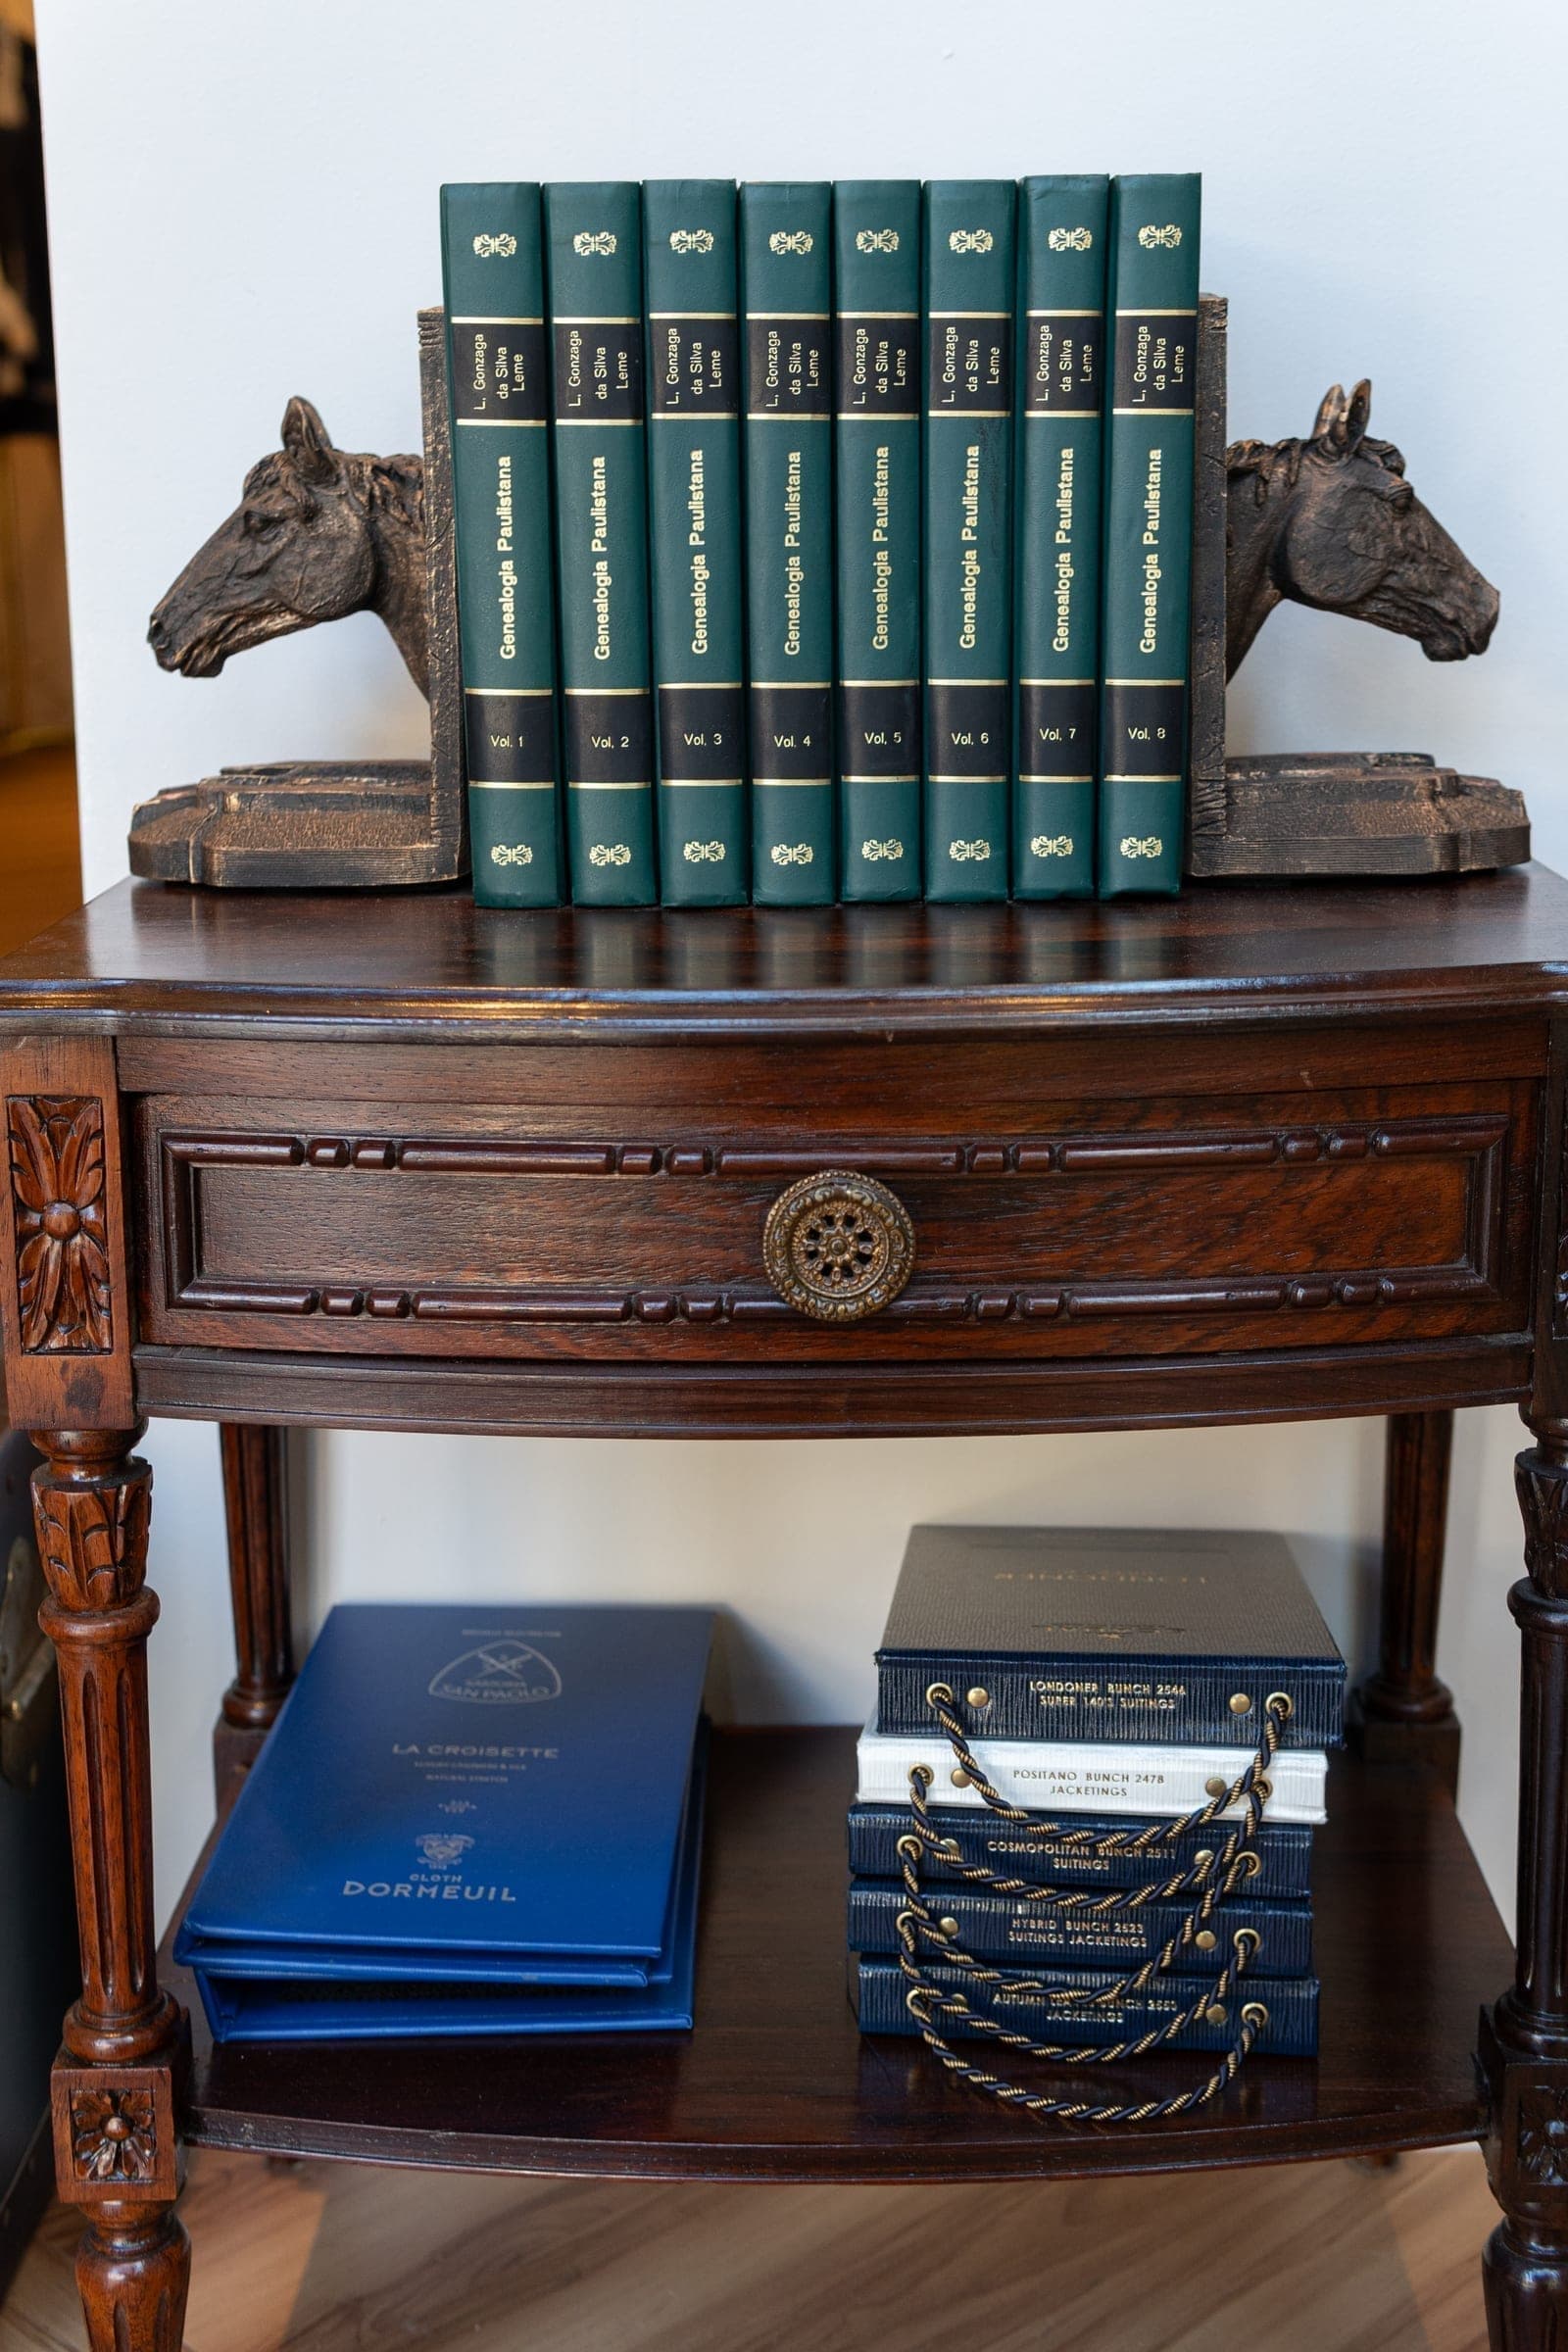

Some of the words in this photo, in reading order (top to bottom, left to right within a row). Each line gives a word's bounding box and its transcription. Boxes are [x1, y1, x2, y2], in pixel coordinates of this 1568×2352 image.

[474, 333, 487, 390] Gonzaga
[496, 347, 508, 378] Silva
[569, 330, 582, 386] Gonzaga
[595, 347, 606, 378] Silva
[666, 327, 680, 384] Gonzaga
[690, 342, 702, 373] Silva
[766, 330, 780, 387] Gonzaga
[790, 342, 802, 374] Silva
[808, 349, 818, 387] Leme
[854, 328, 868, 384] Gonzaga
[876, 341, 888, 372] Silva
[894, 349, 906, 386] Leme
[943, 326, 956, 382] Gonzaga
[966, 339, 978, 370] Silva
[988, 347, 1000, 384] Leme
[1037, 324, 1052, 381] Gonzaga
[1059, 339, 1072, 370] Silva
[1080, 344, 1092, 381] Leme
[1134, 325, 1148, 381] Gonzaga
[1154, 337, 1166, 368] Silva
[1172, 345, 1184, 383] Leme
[513, 354, 524, 392] Leme
[616, 351, 627, 389] Leme
[710, 350, 721, 388] Leme
[966, 376, 978, 392] da
[1059, 376, 1071, 392] da
[1154, 374, 1165, 390] da
[498, 382, 509, 399] da
[569, 394, 581, 407] L.
[596, 382, 607, 399] da
[666, 392, 679, 404] L.
[691, 379, 703, 395] da
[766, 394, 778, 407] L.
[790, 379, 801, 395] da
[854, 392, 865, 404] L.
[876, 378, 888, 394] da
[942, 390, 955, 403] L.
[1037, 389, 1048, 402] L.
[1133, 390, 1145, 402] L.
[474, 398, 486, 410] L.
[496, 456, 513, 552] Paulistana
[591, 457, 607, 552] Paulistana
[688, 450, 705, 545] Paulistana
[785, 452, 800, 547] Paulistana
[873, 447, 889, 541] Paulistana
[961, 446, 979, 540] Paulistana
[1055, 448, 1073, 543] Paulistana
[1143, 449, 1161, 545] Paulistana
[499, 560, 517, 660] Genealogia
[593, 561, 612, 660] Genealogia
[690, 555, 710, 654] Genealogia
[784, 556, 804, 656] Genealogia
[873, 550, 891, 649] Genealogia
[959, 550, 980, 649] Genealogia
[1053, 552, 1074, 652] Genealogia
[1140, 554, 1161, 653] Genealogia
[491, 735, 513, 748] Vol.
[518, 736, 523, 747] 1
[592, 736, 613, 749] Vol.
[621, 736, 629, 748] 2
[684, 733, 706, 746] Vol.
[713, 733, 722, 745] 3
[774, 735, 797, 748] Vol.
[803, 735, 810, 747] 4
[865, 732, 887, 745] Vol.
[894, 733, 902, 744] 5
[952, 733, 973, 746] Vol.
[981, 733, 989, 744] 6
[1040, 728, 1061, 741] Vol.
[1069, 729, 1076, 739] 7
[1128, 727, 1151, 740] Vol.
[1157, 728, 1165, 739] 8
[1030, 1681, 1099, 1693] LONDONER
[1107, 1684, 1150, 1694] BUNCH
[1041, 1695, 1076, 1706] SUPER
[1120, 1698, 1175, 1709] SUITINGS
[393, 1744, 419, 1754] LA
[428, 1744, 559, 1758] CROISETTE
[1013, 1770, 1077, 1781] POSITANO
[1086, 1773, 1129, 1783] BUNCH
[1135, 1775, 1164, 1784] 2478
[1051, 1786, 1127, 1796] JACKETINGS
[988, 1840, 1090, 1855] COSMOPOLITAN
[1098, 1846, 1142, 1857] BUNCH
[1053, 1858, 1109, 1870] SUITINGS
[343, 1881, 516, 1901] DORMEUIL
[410, 1874, 462, 1883] CLOTH
[1009, 1932, 1064, 1943] SUITINGS
[1069, 1936, 1148, 1947] JACKETINGS
[1012, 1919, 1056, 1930] HYBRID
[1066, 1921, 1109, 1932] BUNCH
[1114, 1924, 1144, 1934] 2523
[993, 1994, 1045, 2006] AUTUMN
[1047, 2011, 1124, 2023] JACKETINGS
